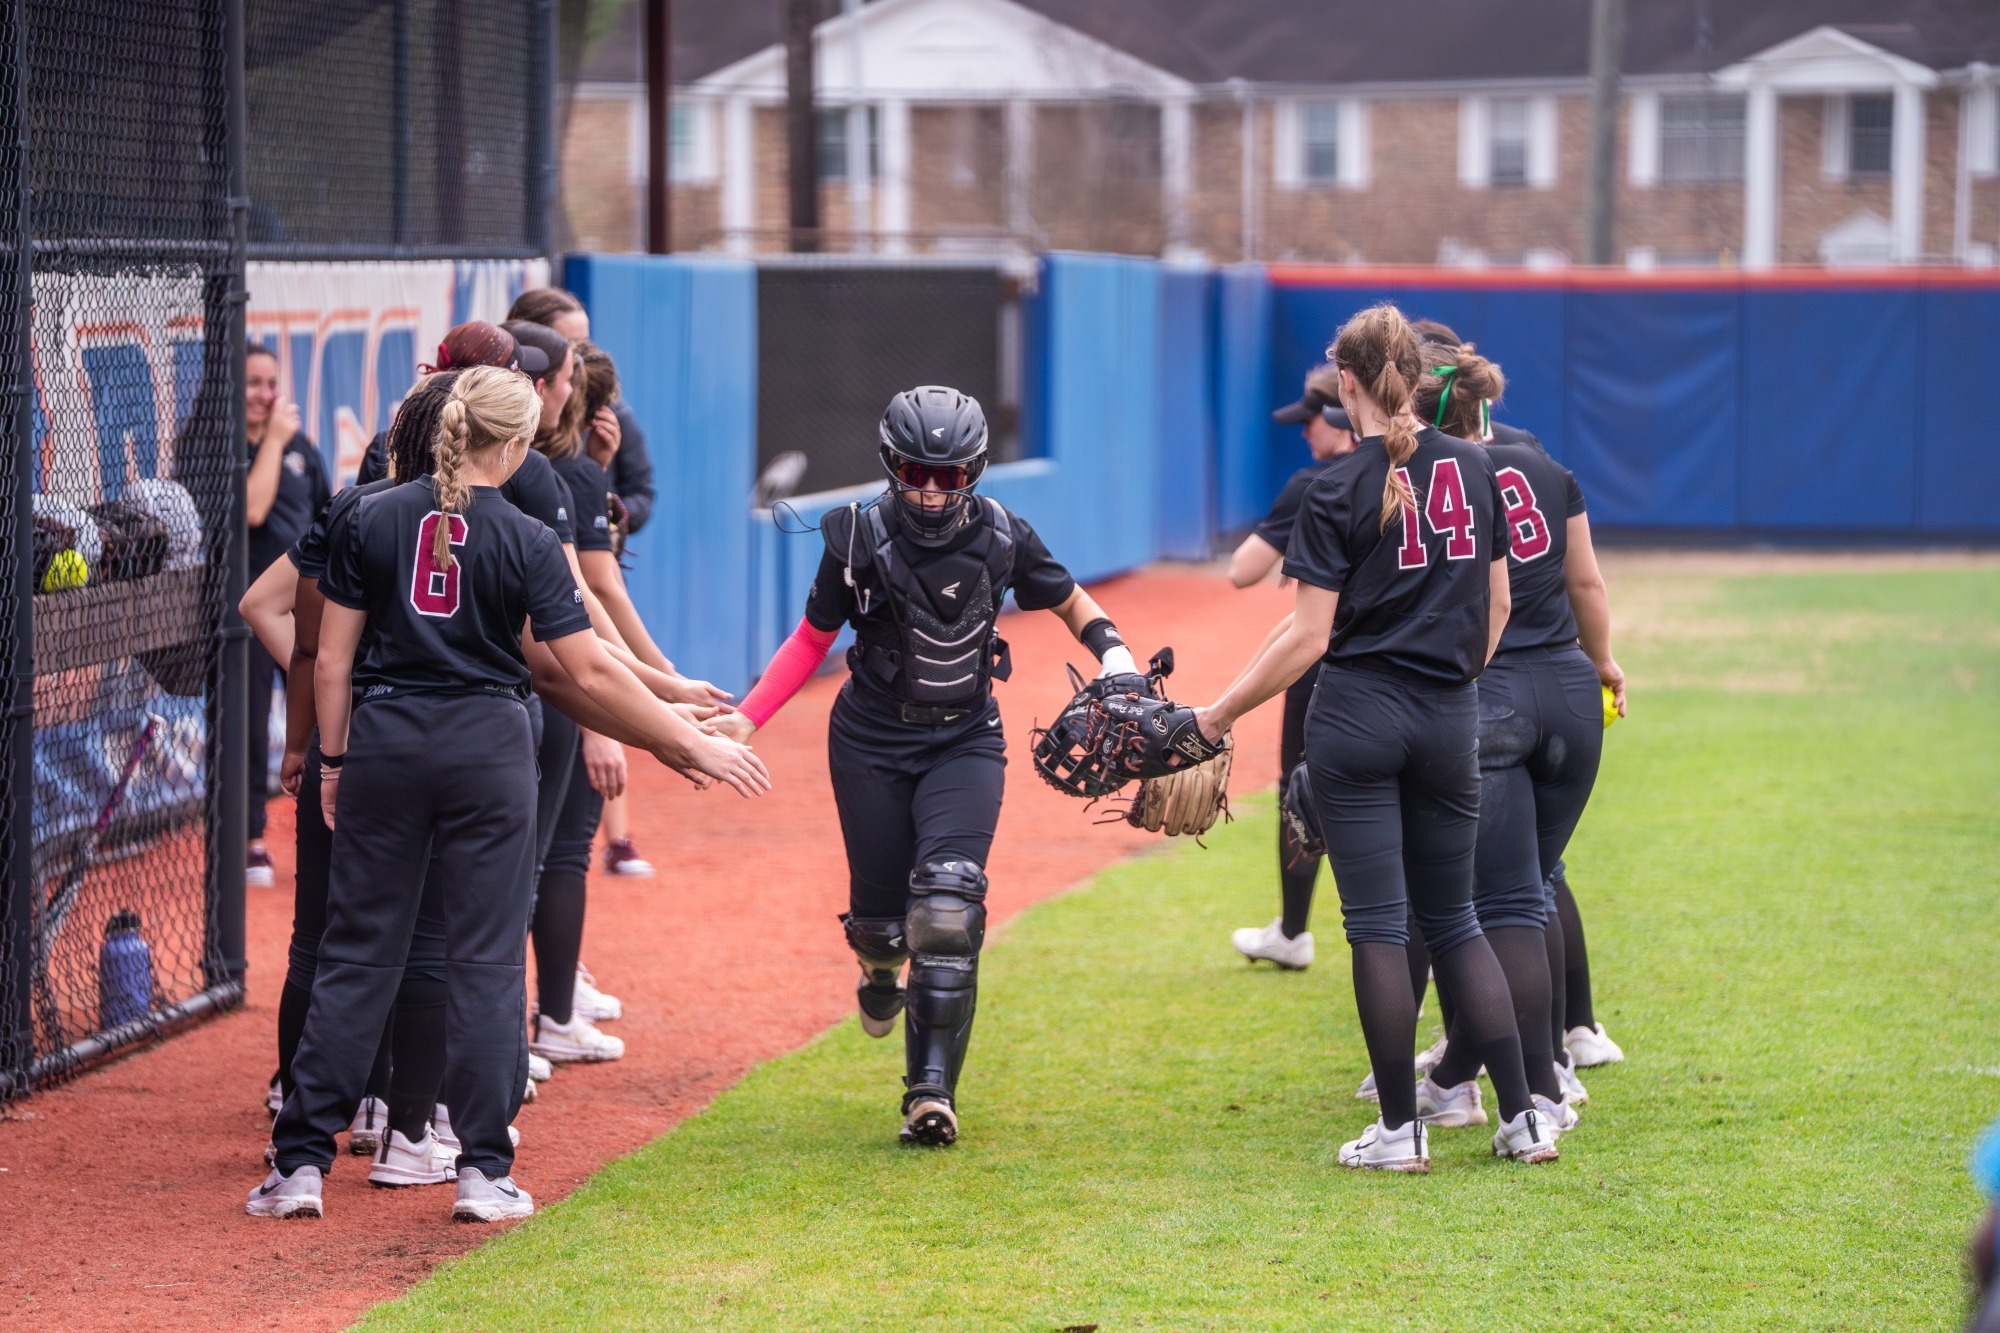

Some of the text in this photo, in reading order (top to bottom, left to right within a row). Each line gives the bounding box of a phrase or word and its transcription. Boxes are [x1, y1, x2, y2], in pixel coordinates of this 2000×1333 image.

[410, 510, 470, 618] 6
[1394, 457, 1475, 570] 14
[1495, 466, 1552, 563] 8
